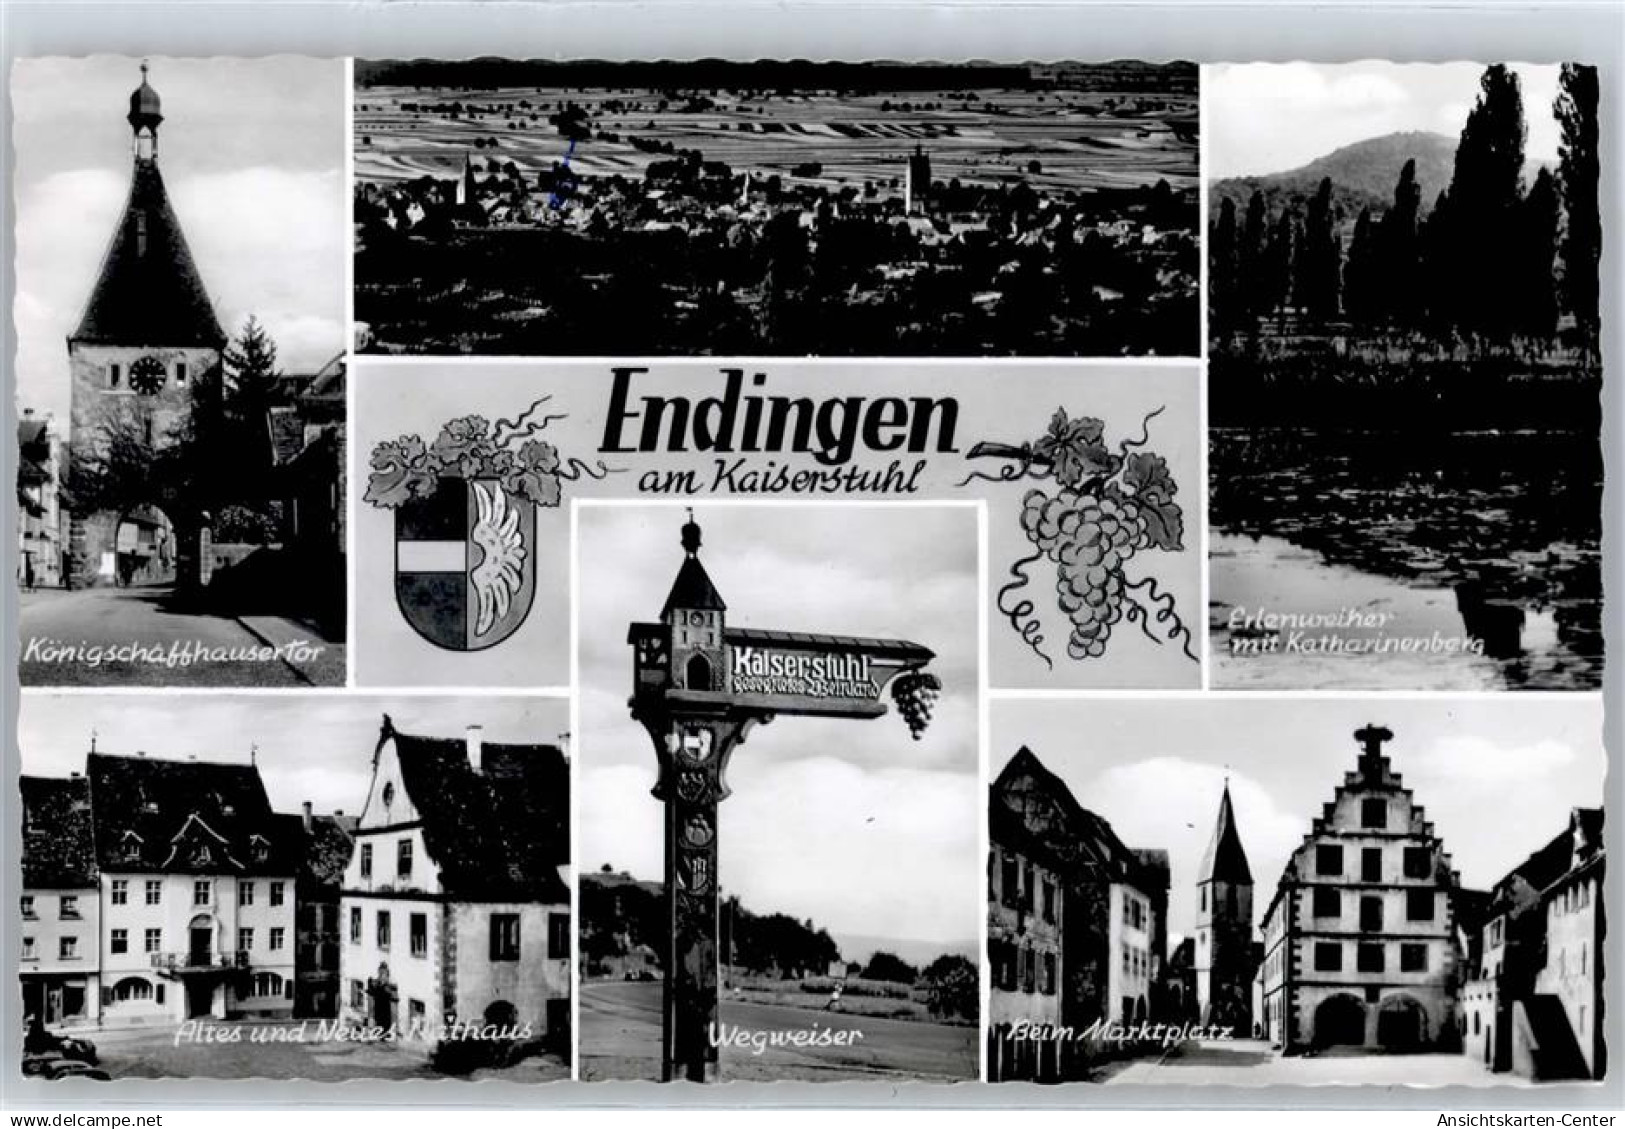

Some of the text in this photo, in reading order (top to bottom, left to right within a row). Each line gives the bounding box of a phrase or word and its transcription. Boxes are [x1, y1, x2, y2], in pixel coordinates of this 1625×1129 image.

[597, 367, 960, 466] Endingen
[638, 458, 927, 494] am Kaiserstuhl
[1227, 606, 1396, 629] Erlenweiher
[1231, 634, 1279, 654] mit
[174, 1020, 243, 1048] Altes
[250, 1021, 307, 1042] und
[313, 1018, 397, 1043] Neues
[708, 1021, 864, 1055] Wegweiser
[1006, 1016, 1235, 1048] Beim Marktplatz
